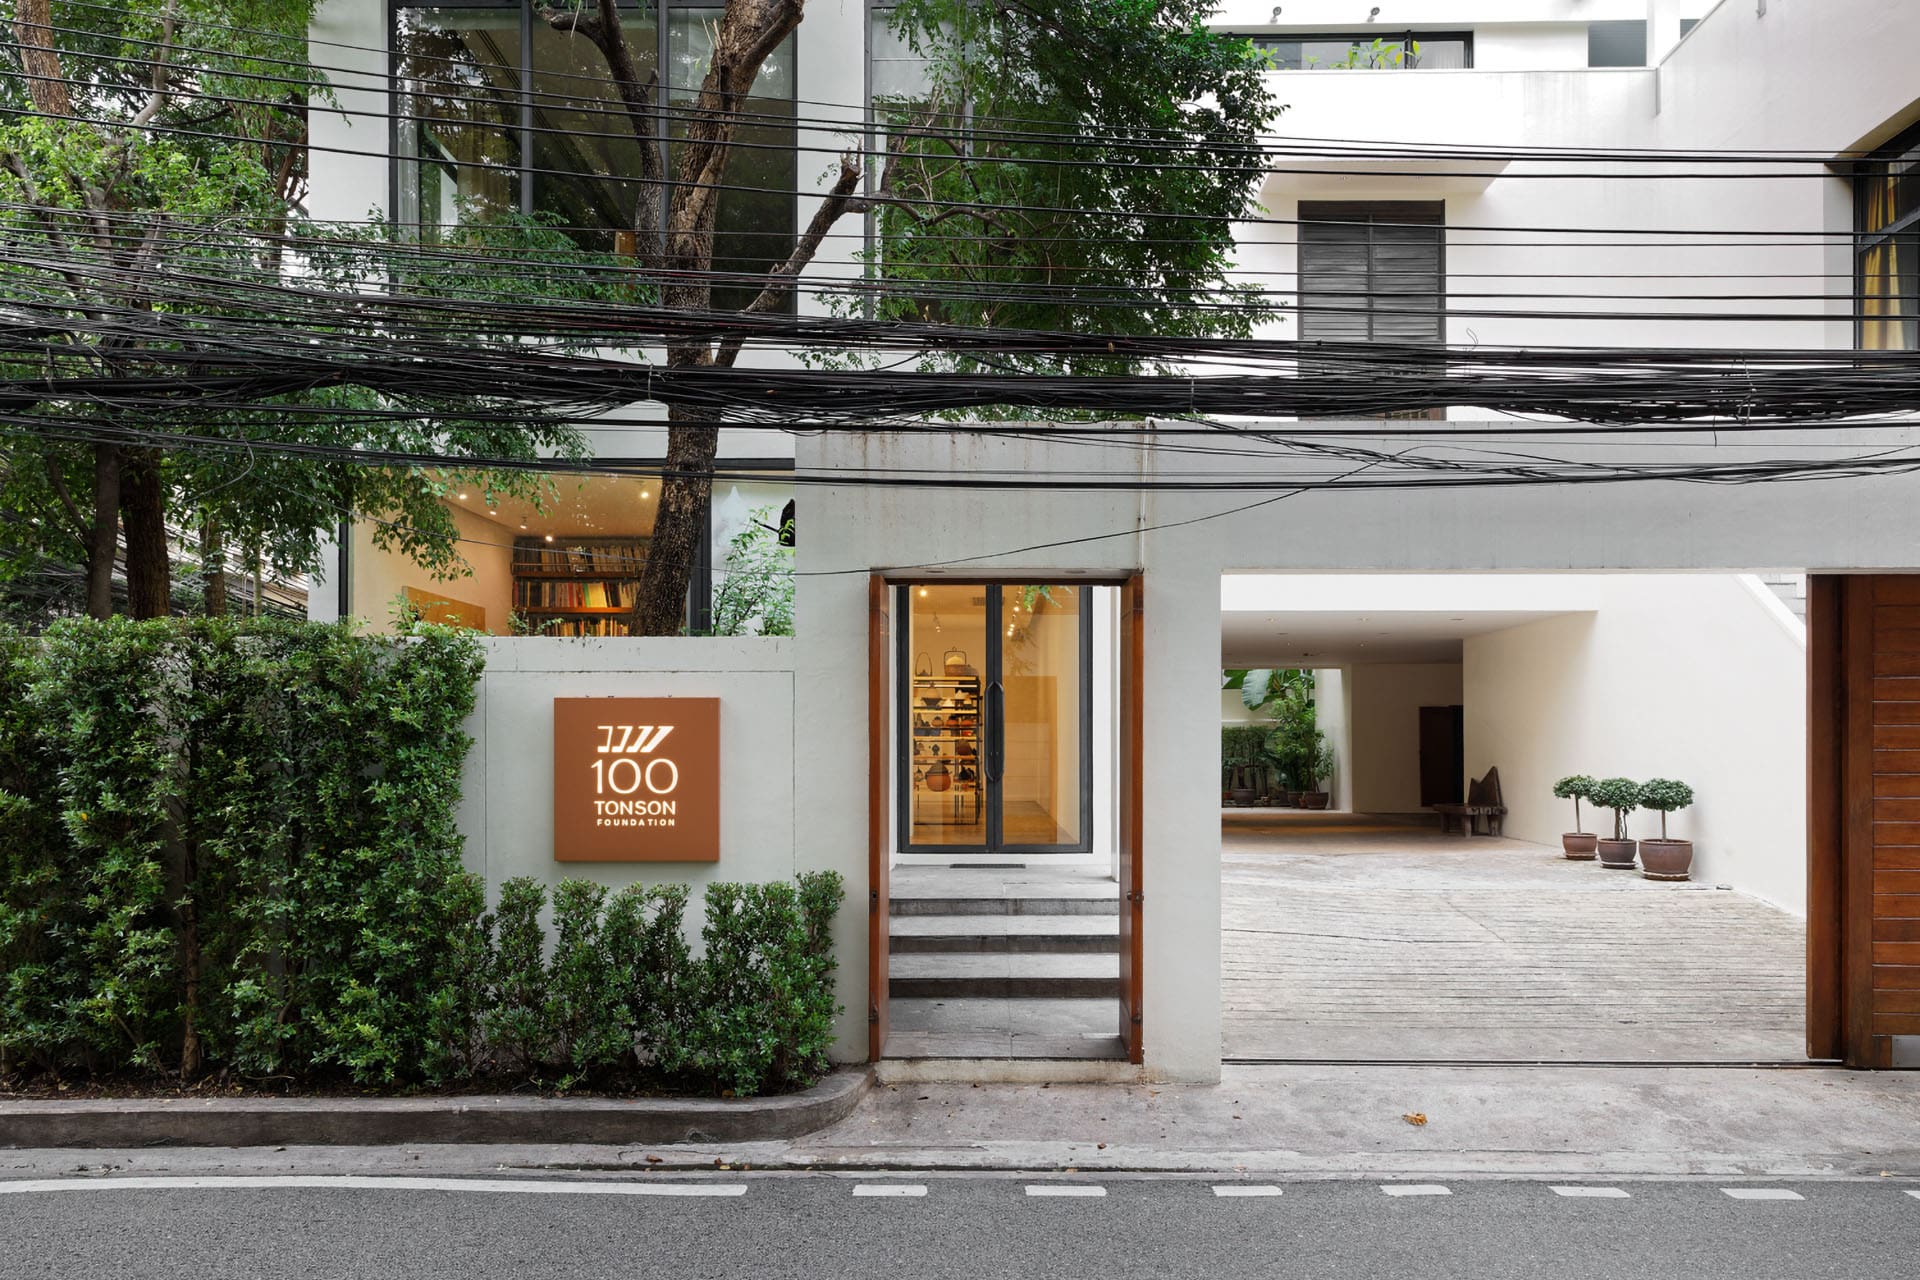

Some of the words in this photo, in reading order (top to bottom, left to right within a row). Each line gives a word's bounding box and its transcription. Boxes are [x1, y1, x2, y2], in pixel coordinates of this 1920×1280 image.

[591, 758, 679, 794] 100
[594, 800, 676, 816] TONSON
[596, 818, 676, 827] FOUNDATION
